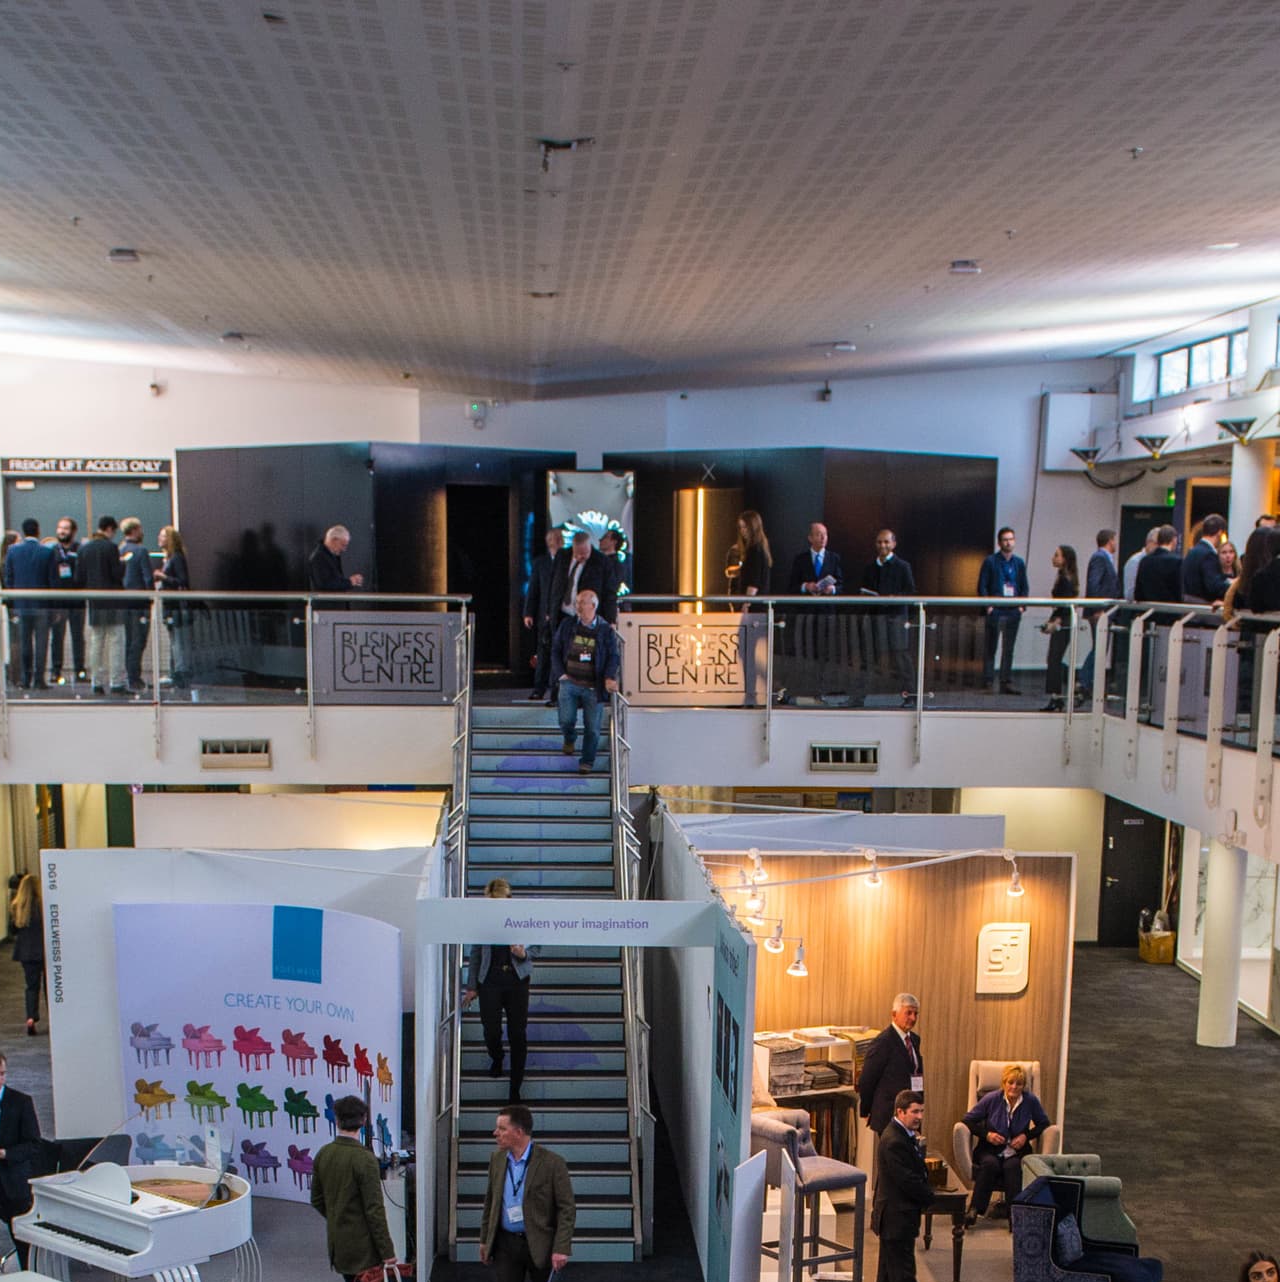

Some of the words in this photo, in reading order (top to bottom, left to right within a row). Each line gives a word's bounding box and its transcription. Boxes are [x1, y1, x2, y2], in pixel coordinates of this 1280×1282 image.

[9, 458, 57, 471] FREIGHT
[59, 459, 82, 471] LIFT
[86, 459, 128, 472] ACCESS
[129, 460, 162, 472] ONLY
[341, 631, 435, 648] BUSINESS
[647, 633, 740, 649] BUSINESS
[341, 645, 433, 665] DESIGN
[341, 662, 435, 684] CENTRE
[646, 664, 739, 685] CENTRE
[47, 863, 58, 890] DG16
[50, 903, 62, 962] EDELWEISS
[504, 917, 550, 929] Awaken
[552, 919, 579, 931] your
[582, 917, 649, 931] imagination
[53, 965, 64, 1004] PIANOS
[223, 992, 282, 1010] CREATE
[285, 997, 323, 1015] YOUR
[326, 1002, 356, 1022] OWN
